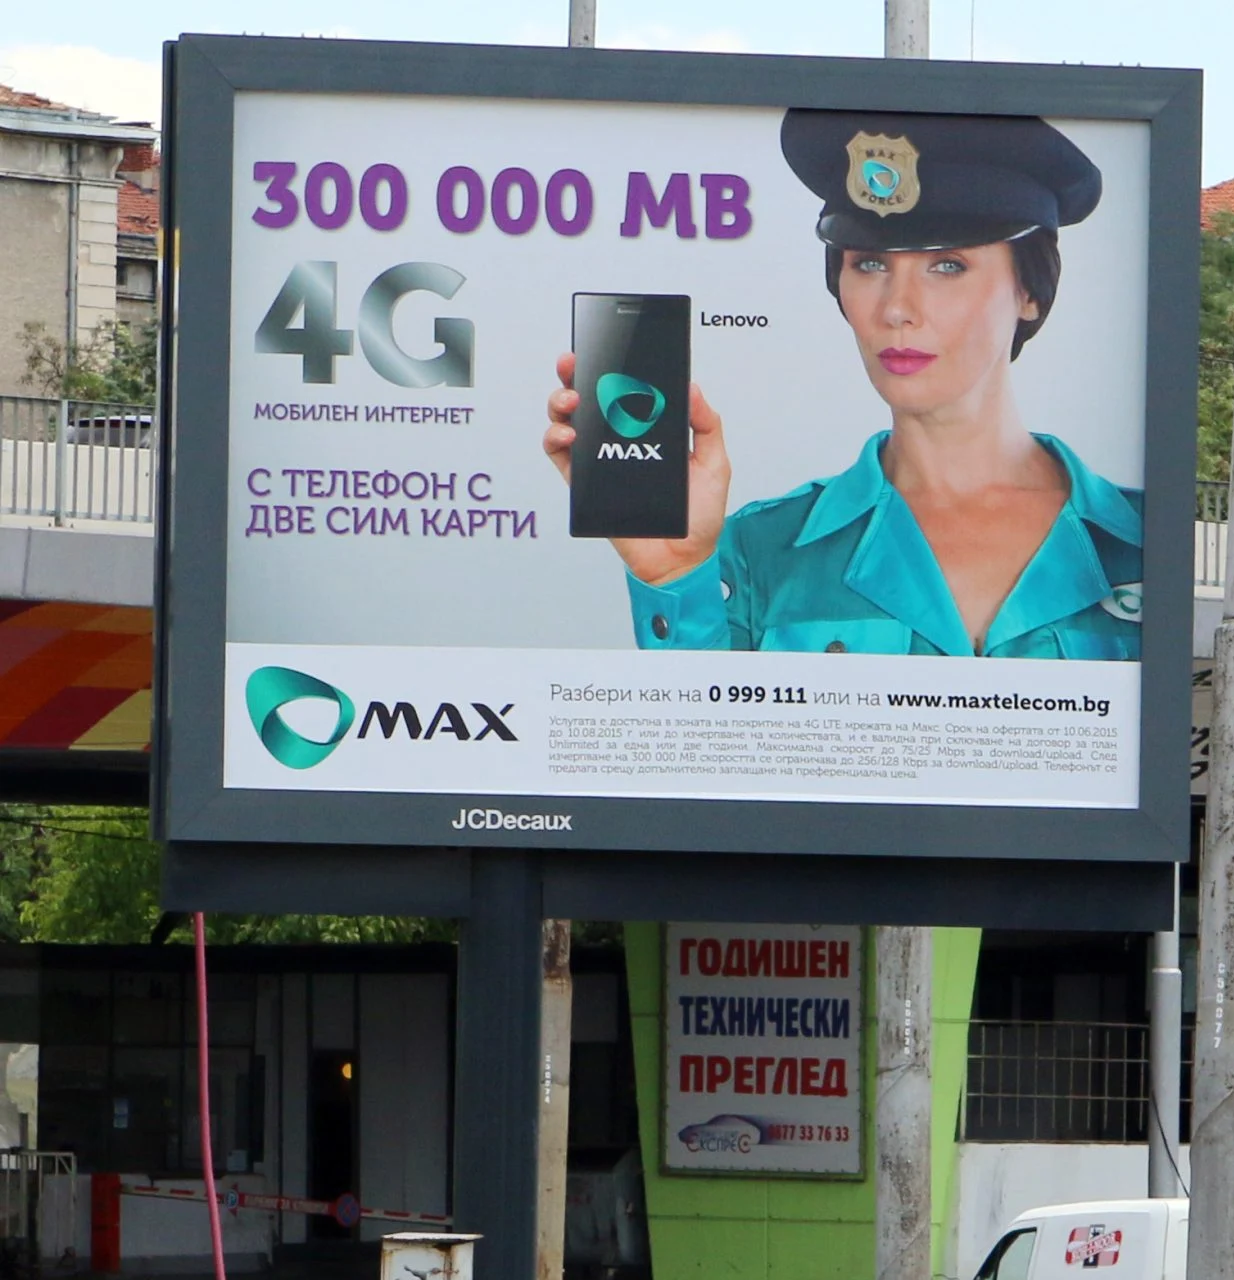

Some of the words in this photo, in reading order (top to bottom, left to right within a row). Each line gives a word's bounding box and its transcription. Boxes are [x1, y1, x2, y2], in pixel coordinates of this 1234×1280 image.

[865, 149, 896, 161] MAX
[252, 161, 408, 232] 300
[436, 166, 594, 237] 000
[620, 171, 752, 240] MB
[860, 191, 904, 206] FORCE
[254, 260, 475, 388] 4G
[701, 312, 768, 328] Lenovo
[253, 402, 358, 422] МОБИЛЕН
[365, 405, 474, 424] ИНТЕРНЕТ
[597, 443, 663, 460] MAX
[247, 469, 272, 497] С
[282, 469, 456, 500] ТЕЛЕФОН
[467, 473, 492, 501] С
[245, 505, 316, 537] ДВЕ
[326, 506, 410, 536] СИМ
[421, 509, 538, 539] КАРТИ
[551, 683, 632, 706] Разбери
[639, 689, 671, 702] как
[679, 689, 701, 702] на
[709, 686, 721, 702] 0
[729, 686, 765, 703] 999
[773, 687, 807, 704] 111
[814, 692, 849, 705] или
[857, 693, 880, 705] на
[888, 692, 1110, 716] www.maxtelecom.bg
[357, 701, 519, 741] MAX
[549, 715, 596, 727] Услугата
[610, 717, 662, 728] достъпна
[675, 719, 711, 727] зоната
[732, 720, 784, 729] покритие
[823, 719, 841, 729] LTE
[845, 723, 892, 733] мрежата
[945, 723, 972, 734] Срок
[992, 725, 1043, 737] офертата
[1064, 726, 1117, 738] 10.06.2015
[568, 727, 622, 739] 10.08.2015
[683, 731, 745, 740] изчерпване
[872, 736, 916, 744] валидна
[921, 737, 941, 747] при
[946, 737, 1003, 746] сключване
[1026, 740, 1071, 749] договор
[1092, 741, 1117, 749] план
[549, 739, 599, 749] Unlimited
[624, 741, 649, 752] една
[656, 743, 676, 751] или
[683, 743, 701, 753] две
[757, 743, 823, 752] Максимална
[830, 745, 874, 757] скорост
[903, 746, 931, 758] 75/25
[938, 747, 965, 758] Mbps
[1091, 750, 1117, 762] След
[549, 752, 611, 762] изчерпване
[632, 751, 651, 761] 300
[656, 751, 676, 762] 000
[700, 754, 756, 765] скоростта
[776, 756, 836, 767] ограничава
[858, 756, 899, 767] 256/128
[903, 757, 928, 768] Kbps
[1044, 761, 1102, 773] Телефонът
[549, 761, 597, 774] предлага
[600, 765, 635, 775] срещу
[720, 767, 777, 775] заплащане
[452, 808, 572, 831] JCDecaux
[679, 938, 849, 978] ГОДИШЕН
[678, 995, 849, 1038] ТЕХНИЧЕСКИ
[679, 1054, 848, 1097] ПРЕГЛЕД
[768, 1124, 796, 1140] 0877
[800, 1125, 814, 1141] 33
[818, 1125, 832, 1141] 76
[835, 1126, 849, 1142] 33
